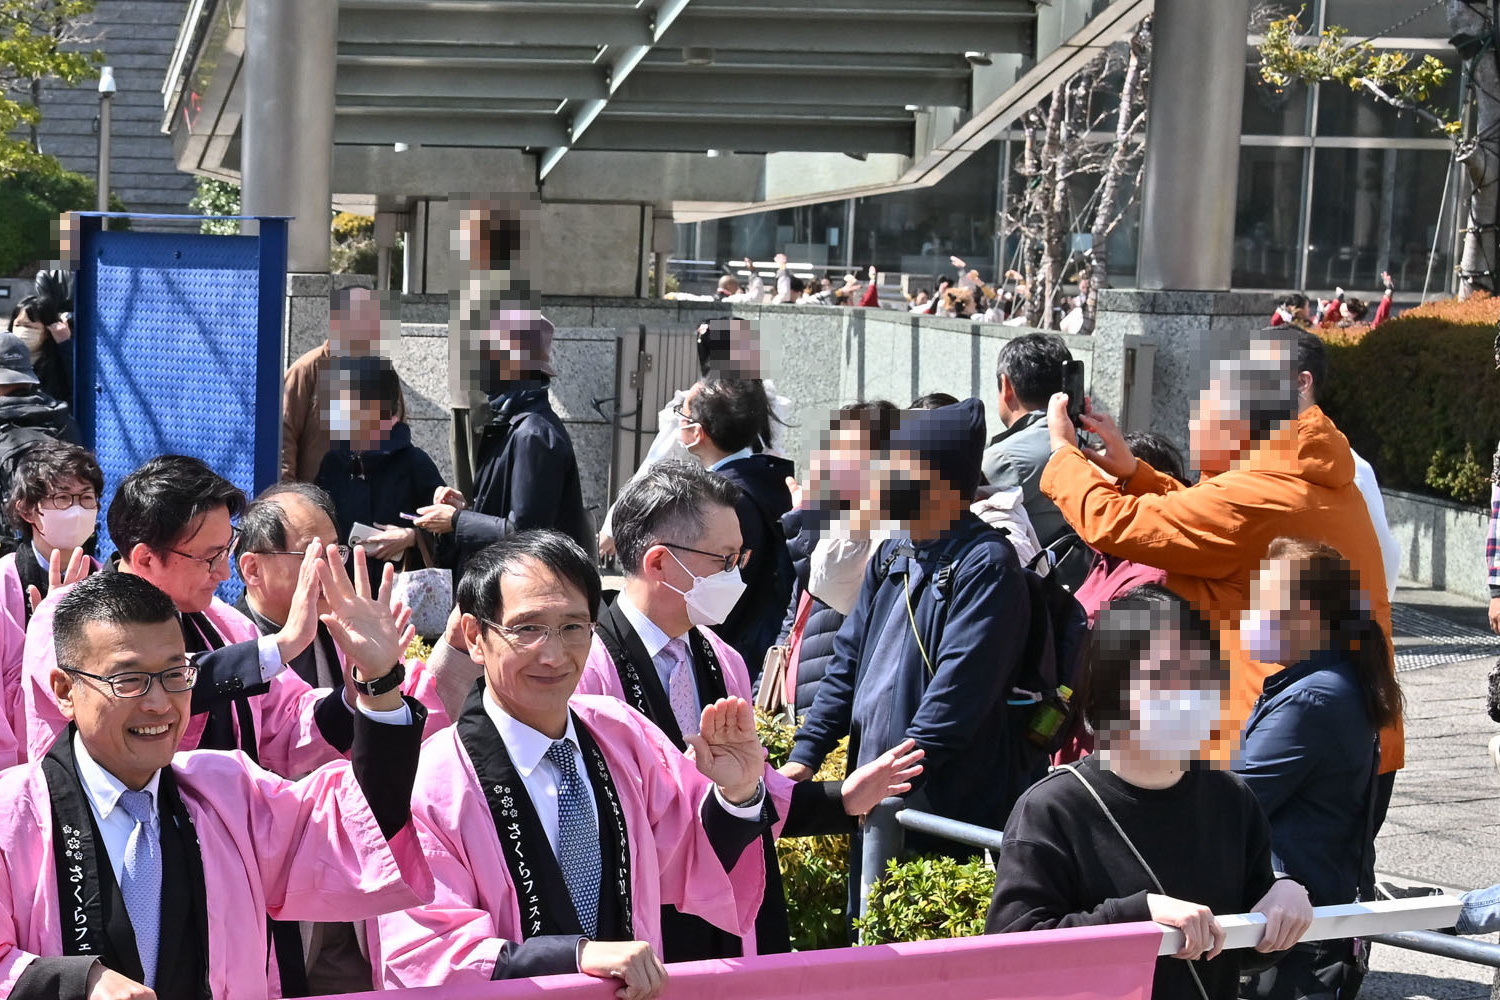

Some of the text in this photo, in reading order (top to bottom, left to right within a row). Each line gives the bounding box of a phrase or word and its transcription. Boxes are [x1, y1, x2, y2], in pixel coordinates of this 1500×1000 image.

[507, 822, 541, 936] さくらフェスタ
